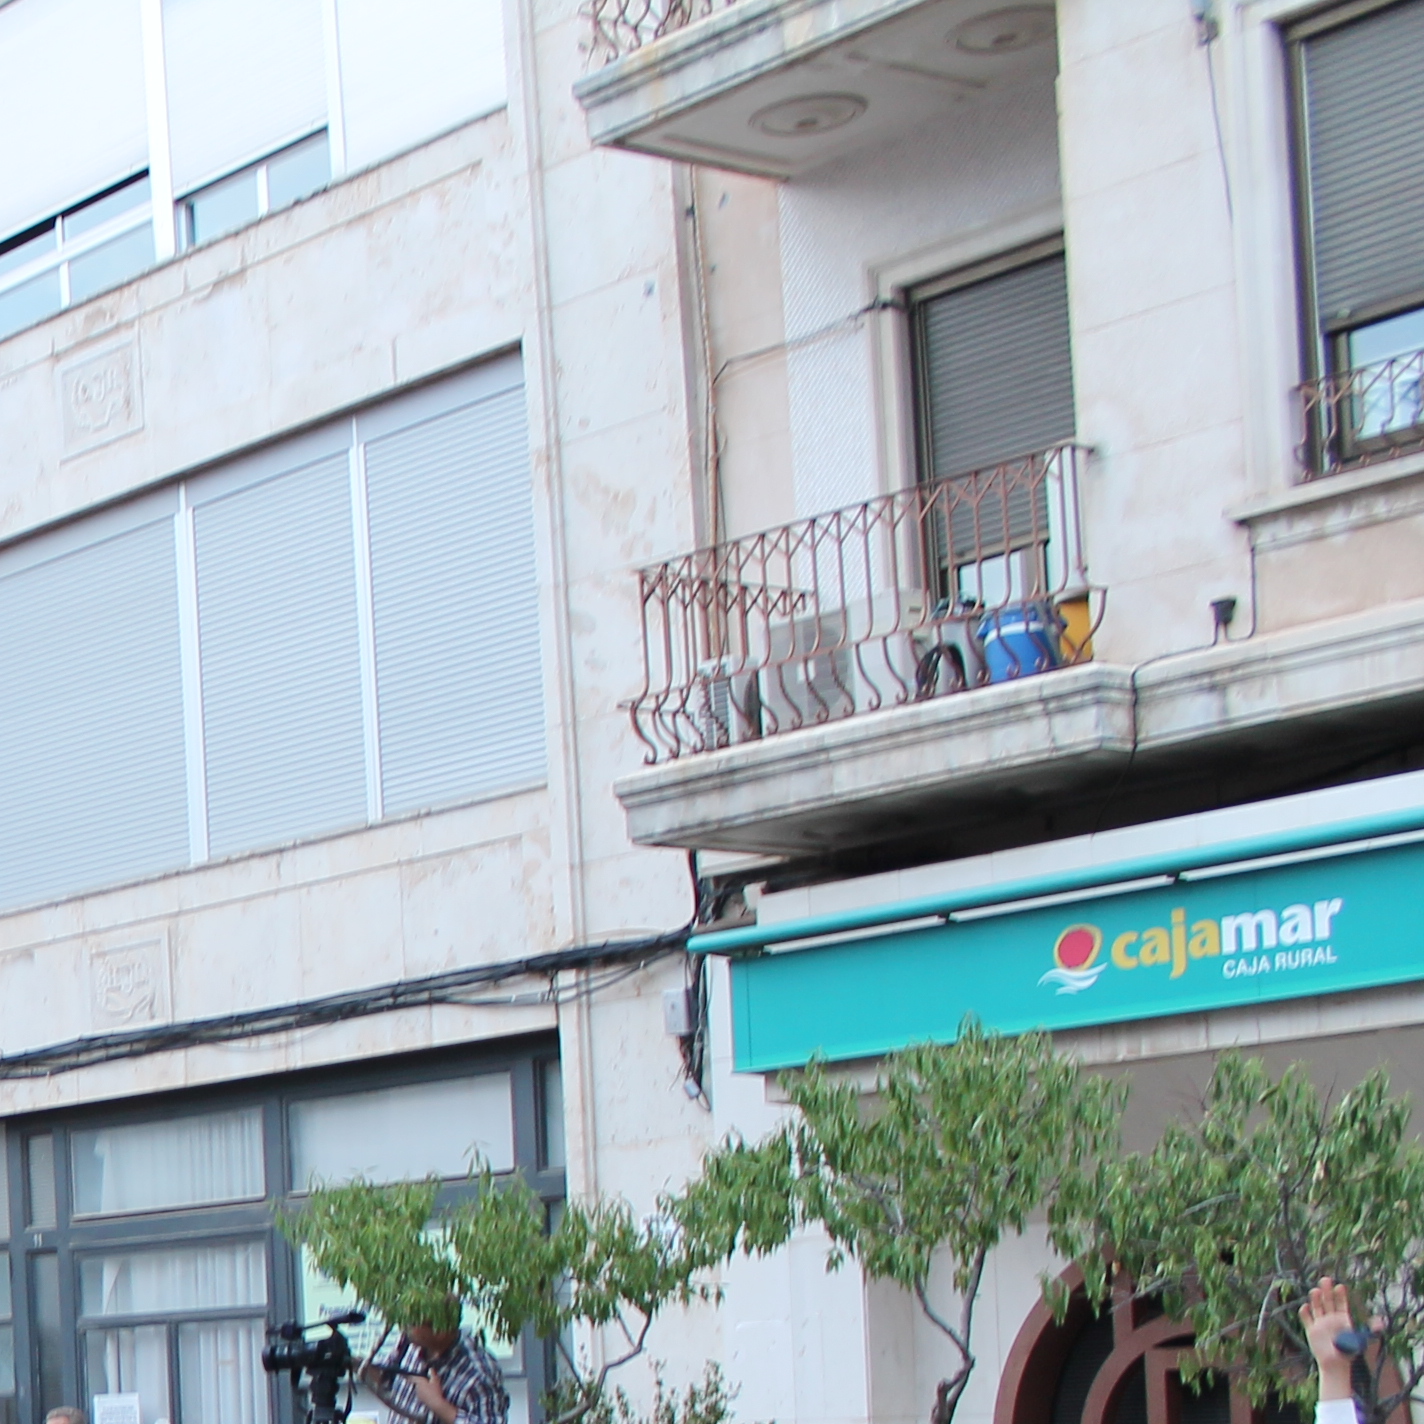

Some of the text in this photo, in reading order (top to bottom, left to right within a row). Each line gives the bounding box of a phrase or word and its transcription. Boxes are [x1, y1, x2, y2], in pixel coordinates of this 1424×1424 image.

[1111, 898, 1343, 979] cajamar
[1223, 945, 1338, 979] CAJA RURAL
